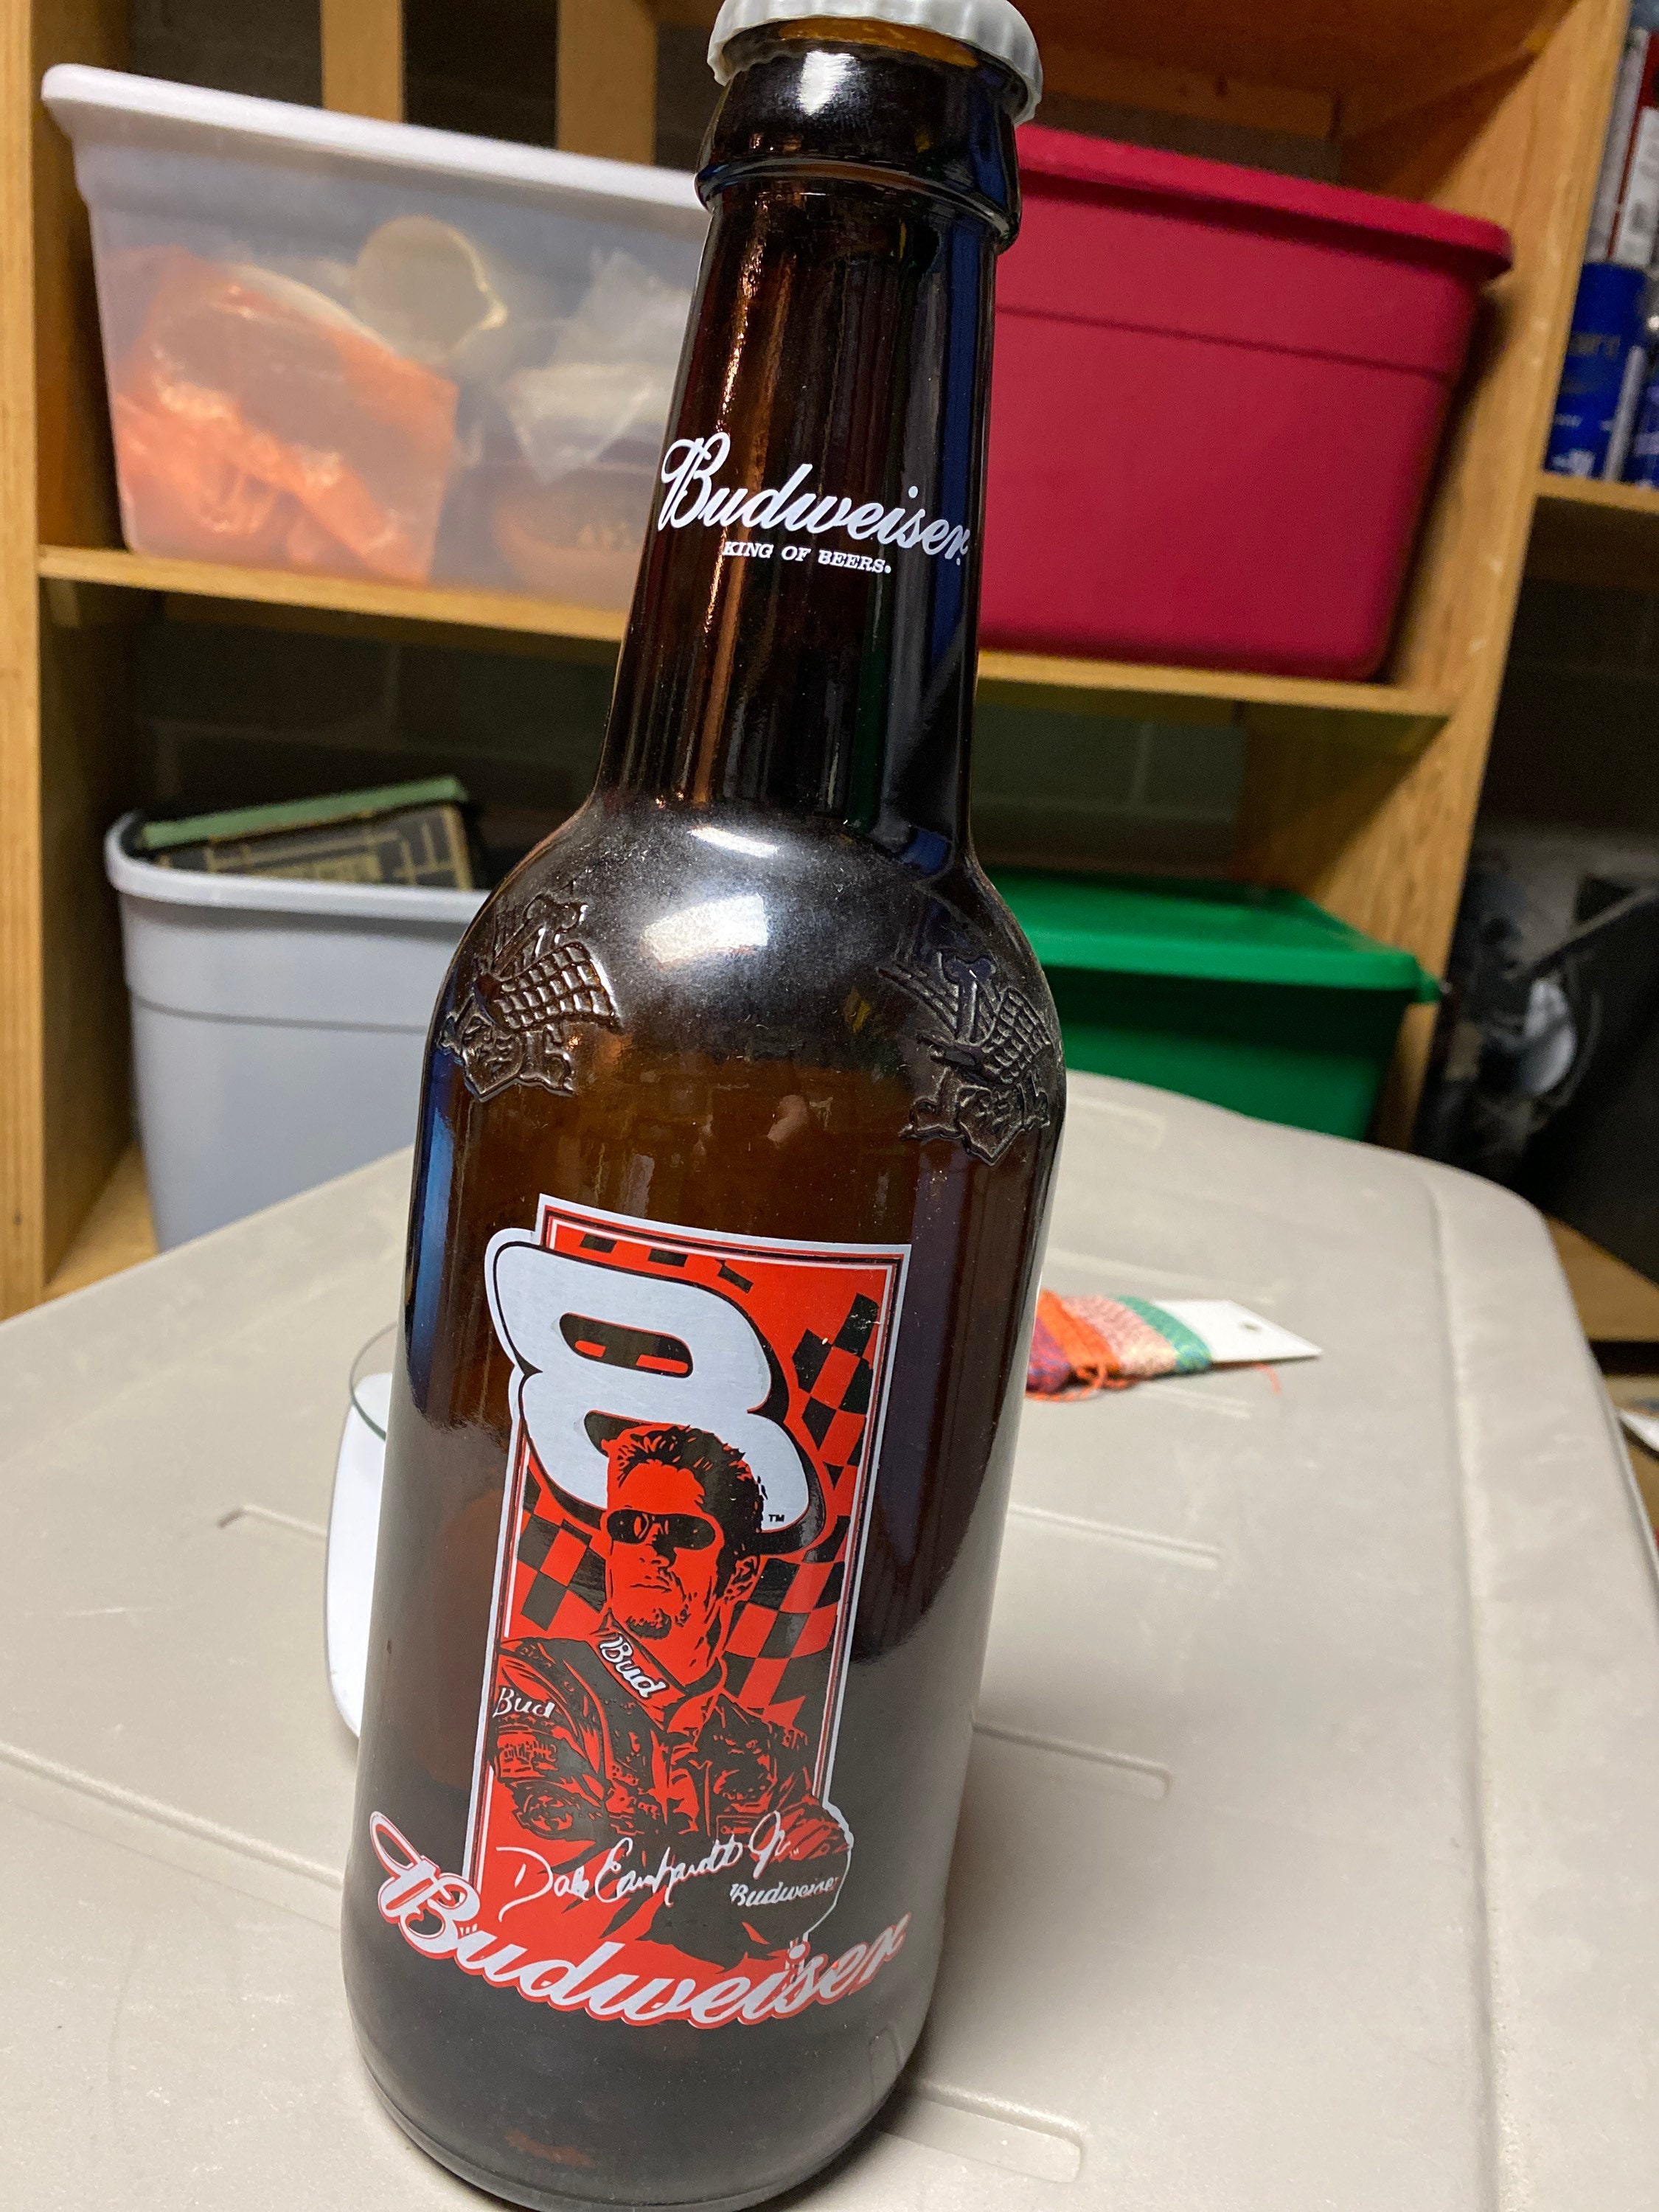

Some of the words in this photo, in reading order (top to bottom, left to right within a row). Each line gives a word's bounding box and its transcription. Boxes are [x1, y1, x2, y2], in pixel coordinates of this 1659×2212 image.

[658, 432, 971, 560] Budweiser
[722, 541, 774, 559] KING
[781, 546, 812, 562] OF
[487, 1233, 818, 1541] 8
[492, 1687, 555, 1719] Bud
[599, 1635, 668, 1699] Bud
[369, 1811, 911, 2026] Budweiser
[495, 1846, 591, 1923] Dale
